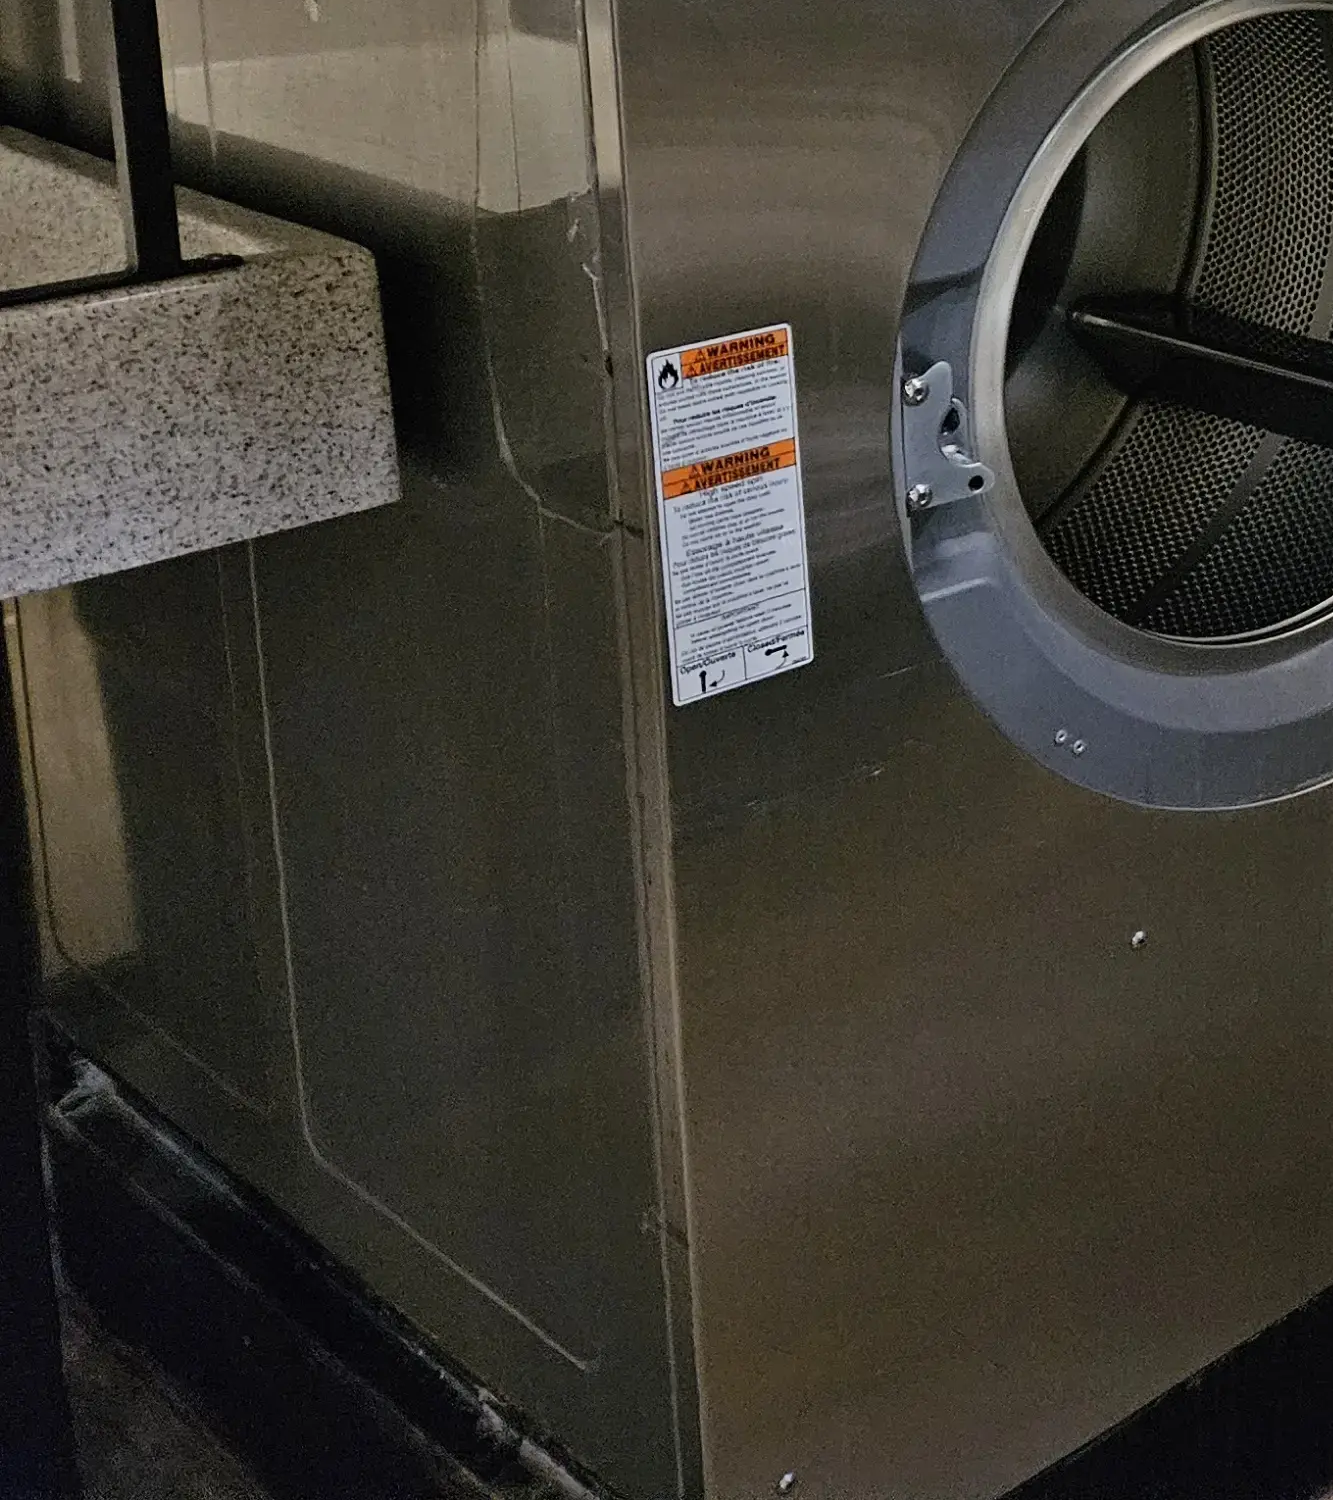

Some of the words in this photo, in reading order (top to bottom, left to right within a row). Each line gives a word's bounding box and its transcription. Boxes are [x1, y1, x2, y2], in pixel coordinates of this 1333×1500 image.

[700, 344, 785, 373] AVERTISSEMENT
[707, 333, 775, 357] WARNING
[702, 446, 770, 472] WARNING
[695, 457, 781, 491] AVERTISSEMENT
